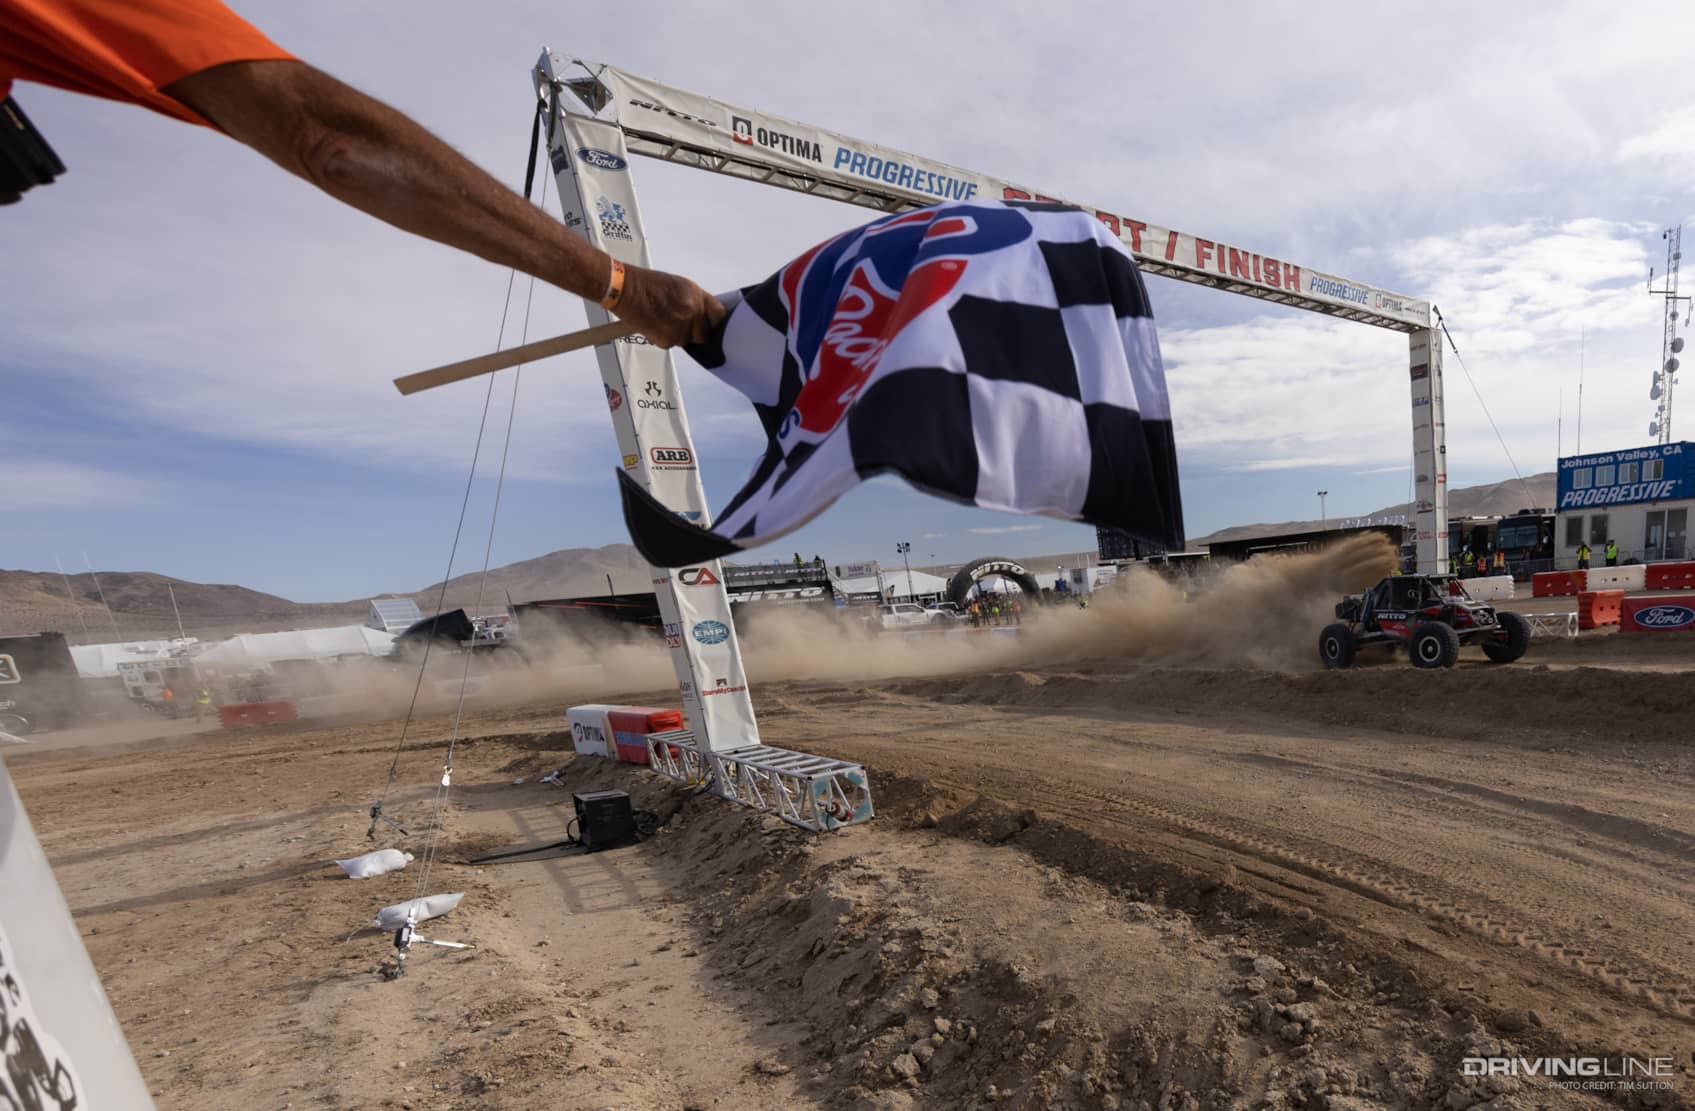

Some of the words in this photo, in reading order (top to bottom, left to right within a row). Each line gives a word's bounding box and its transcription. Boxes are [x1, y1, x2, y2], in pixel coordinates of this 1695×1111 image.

[757, 127, 823, 163] OPTIMA
[587, 151, 618, 169] Ford
[834, 147, 977, 201] PROGRESSIVE
[1195, 238, 1301, 293] FINISH
[1310, 276, 1369, 305] PROGRESSIVE
[655, 450, 689, 461] ARB
[1561, 455, 1614, 469] Johnson
[1616, 449, 1659, 461] Valley,
[1662, 445, 1682, 456] CA
[1560, 480, 1676, 507] PROGRESSIVE
[969, 561, 1026, 582] NITTO
[1645, 608, 1685, 624] Ford
